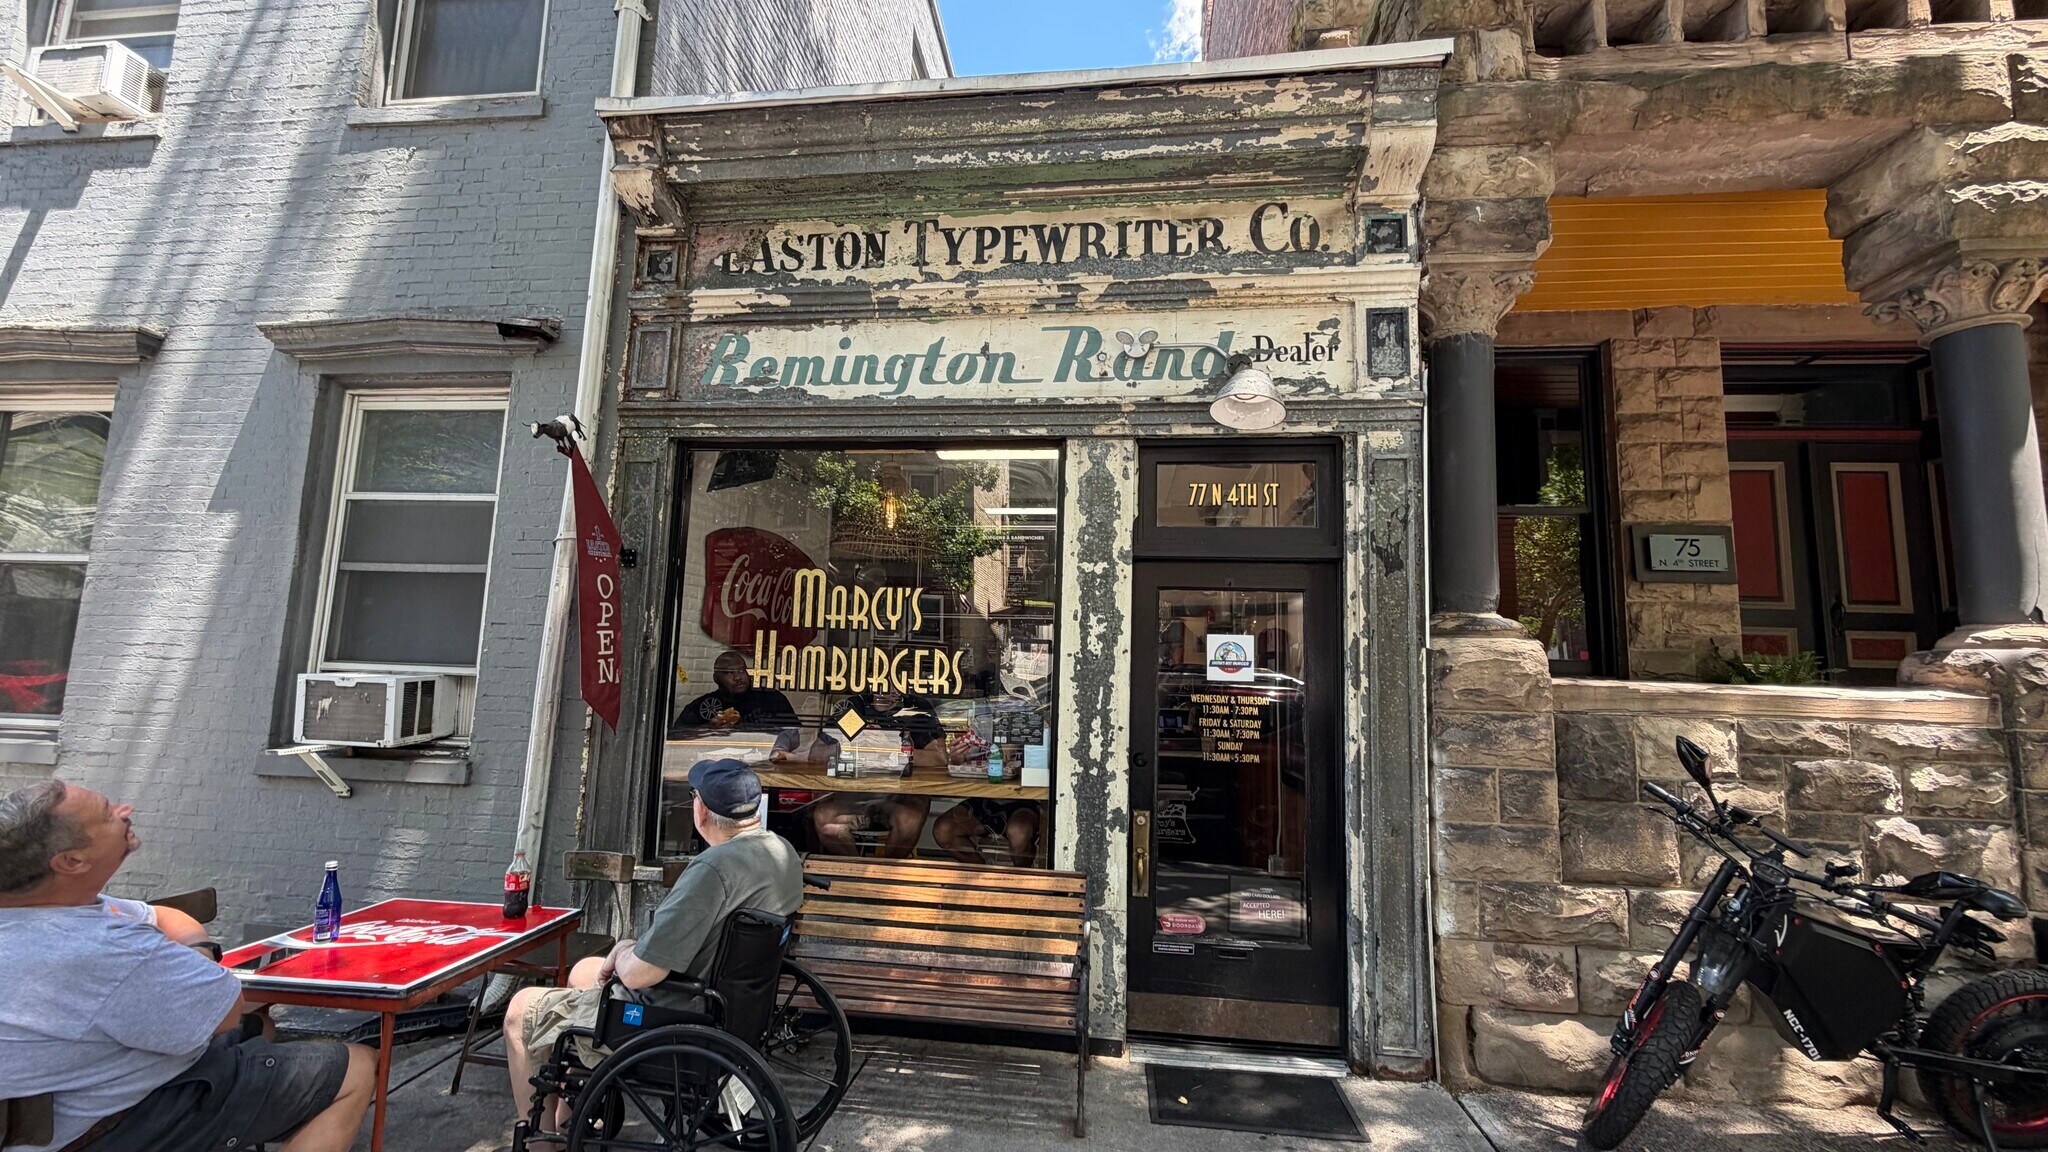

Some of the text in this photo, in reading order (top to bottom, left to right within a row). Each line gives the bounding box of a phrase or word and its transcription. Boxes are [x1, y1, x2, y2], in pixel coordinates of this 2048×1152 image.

[904, 217, 1231, 267] TYPEWRITER
[1252, 332, 1339, 366] Dealer
[700, 325, 1236, 396] Remington Rand
[1188, 483, 1279, 506] 77 N 4TH ST
[1674, 538, 1701, 557] 75
[1659, 559, 1668, 567] N
[1688, 559, 1720, 568] STREET
[721, 553, 798, 625] Coca-Co
[792, 567, 924, 631] MARCY'S
[597, 573, 615, 684] OPEN
[745, 629, 964, 695] HAMBURGERS
[1190, 693, 1271, 706] WEDNESDAY & THURSDAY
[1202, 705, 1230, 715] 11:30AM
[1235, 706, 1259, 716] 7:30PM
[1199, 717, 1262, 729] FRIDAY & SATURDAY
[1203, 728, 1230, 738] 11:30AM
[1236, 729, 1260, 739] 7:30PM
[1217, 741, 1243, 751] SUNDAY
[1203, 752, 1230, 762] 11:30AM
[1235, 754, 1260, 764] 5:30PM
[1258, 909, 1285, 919] HERE!
[1783, 1009, 1821, 1061] NCC-1701
